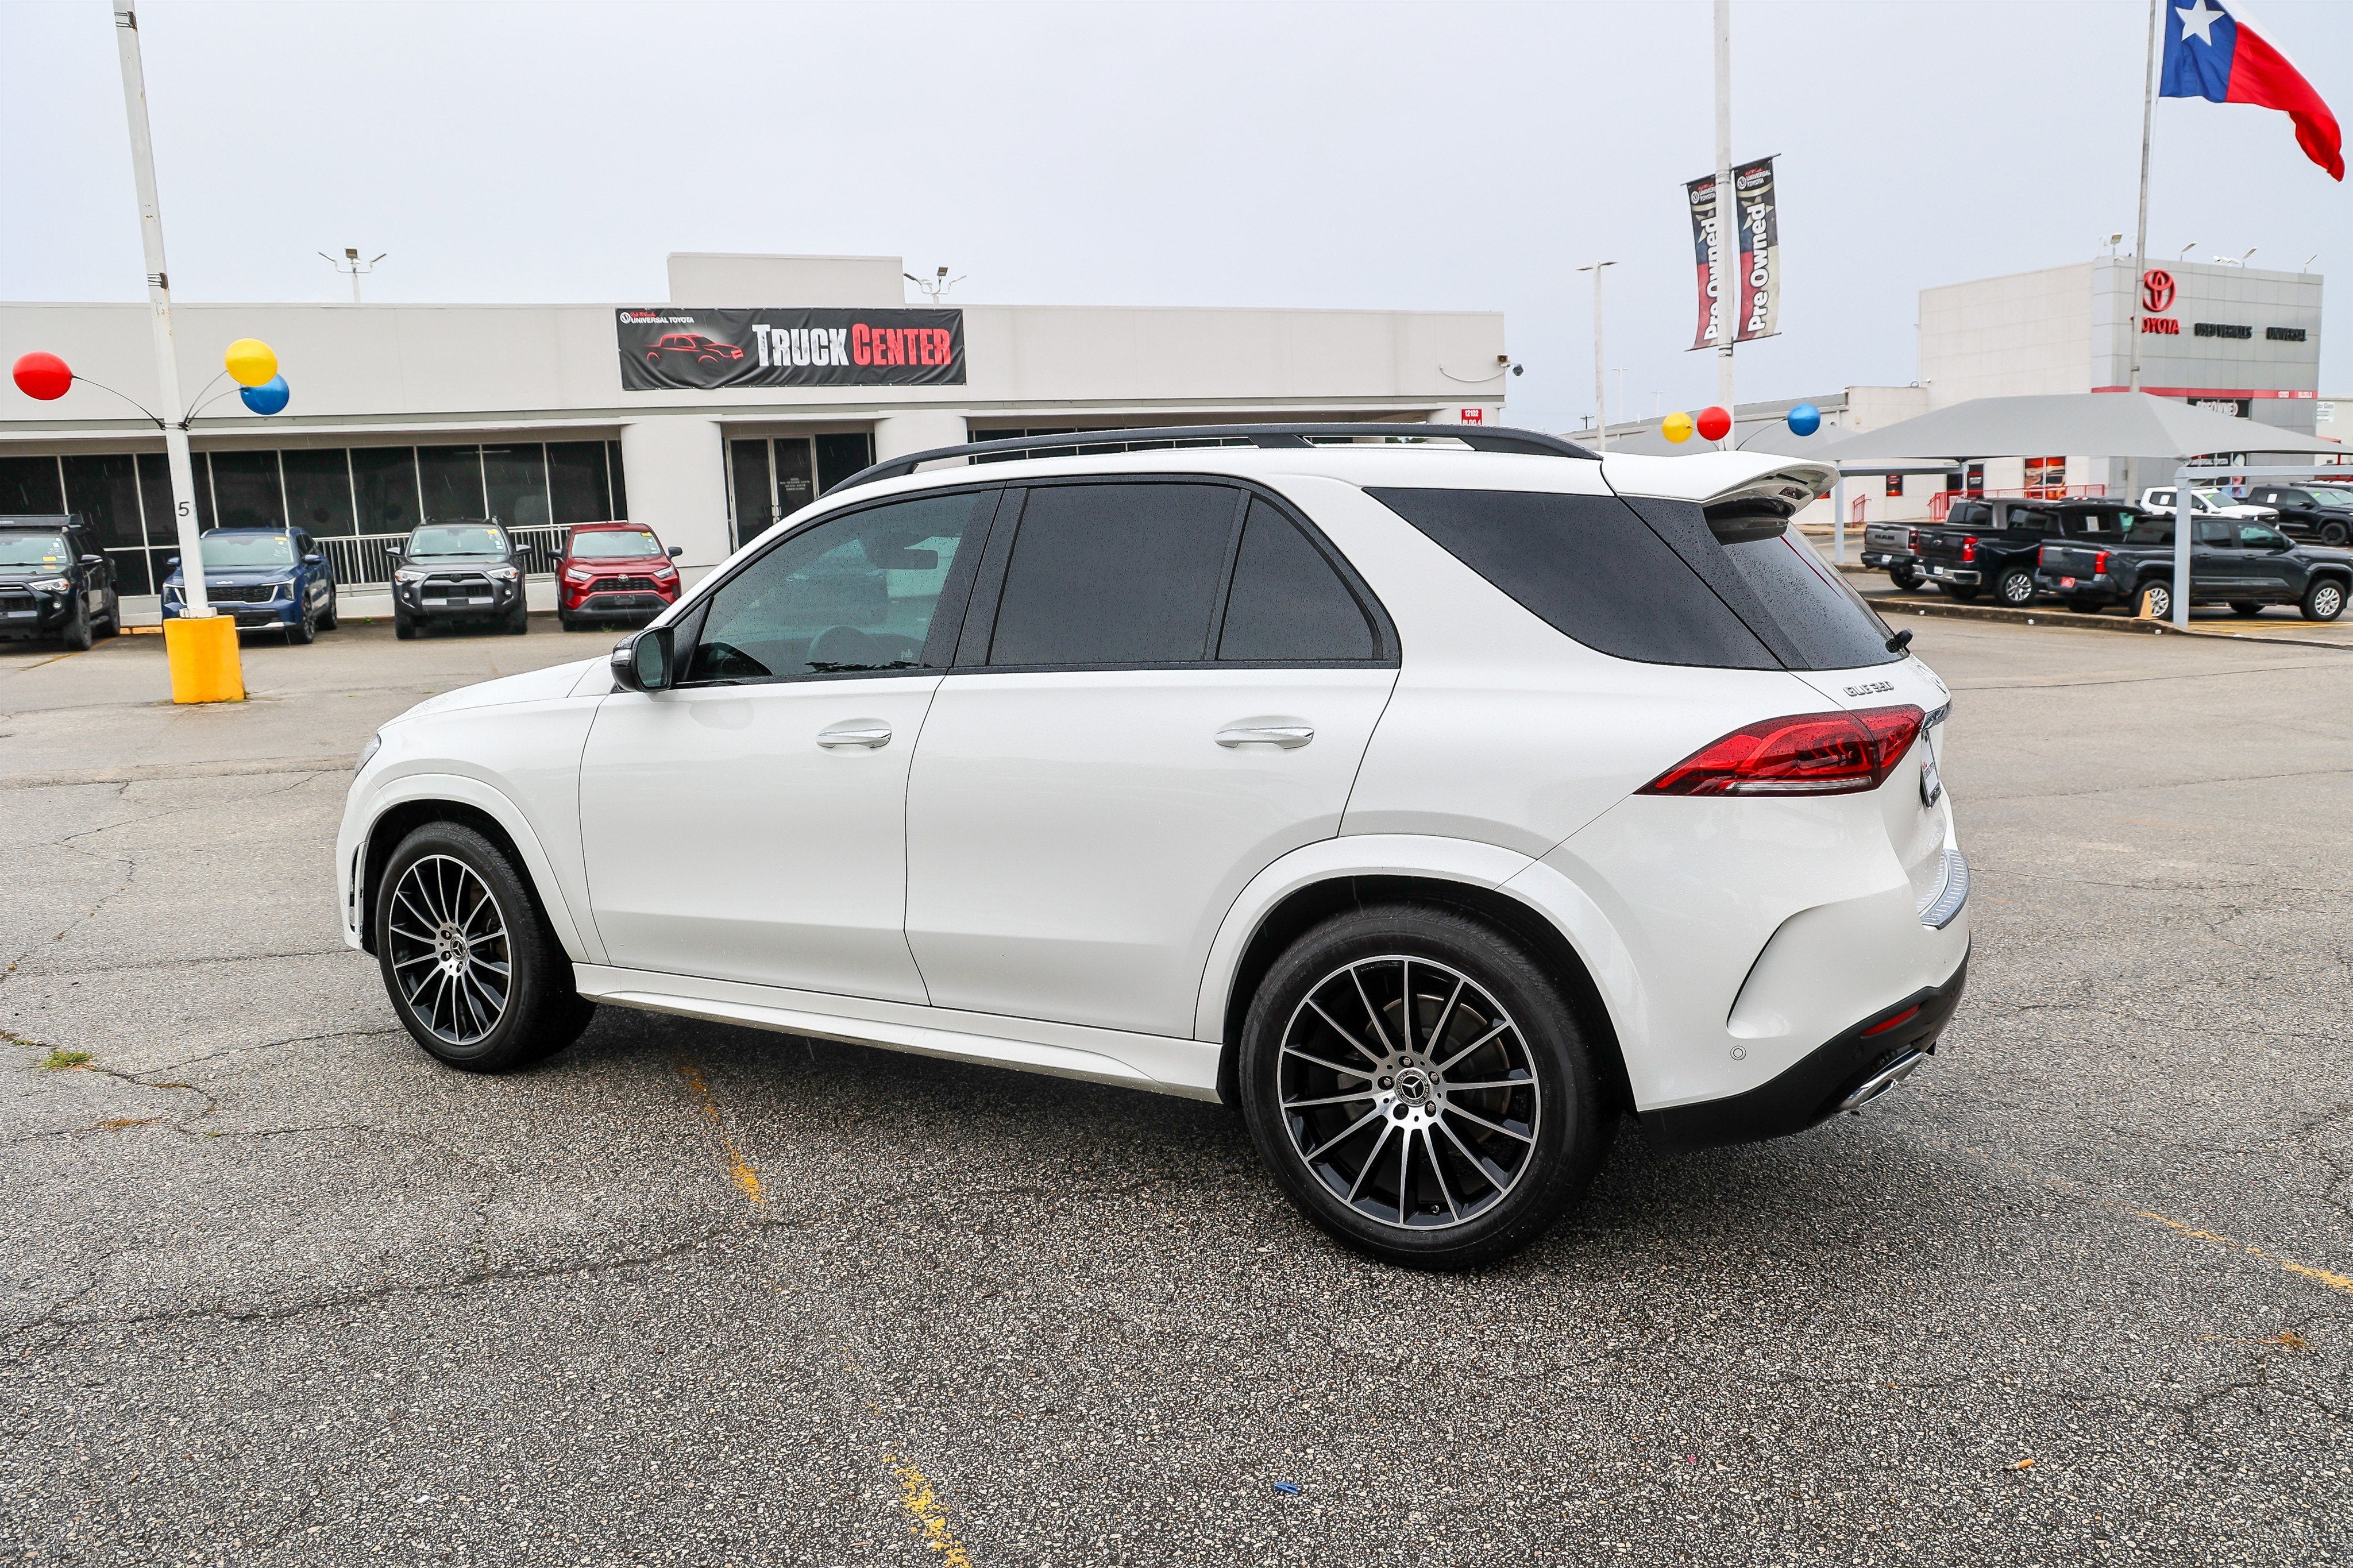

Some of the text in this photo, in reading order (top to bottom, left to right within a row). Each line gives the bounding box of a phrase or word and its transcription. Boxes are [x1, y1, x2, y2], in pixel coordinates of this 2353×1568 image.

[1699, 187, 1716, 195] UNIVER
[1747, 202, 1769, 288] Owned
[1747, 291, 1769, 332] Pre
[2131, 316, 2180, 335] OYOTA
[751, 323, 952, 367] TRUCK CENTER
[178, 501, 190, 517] 5
[1843, 681, 1895, 697] GLE 350
